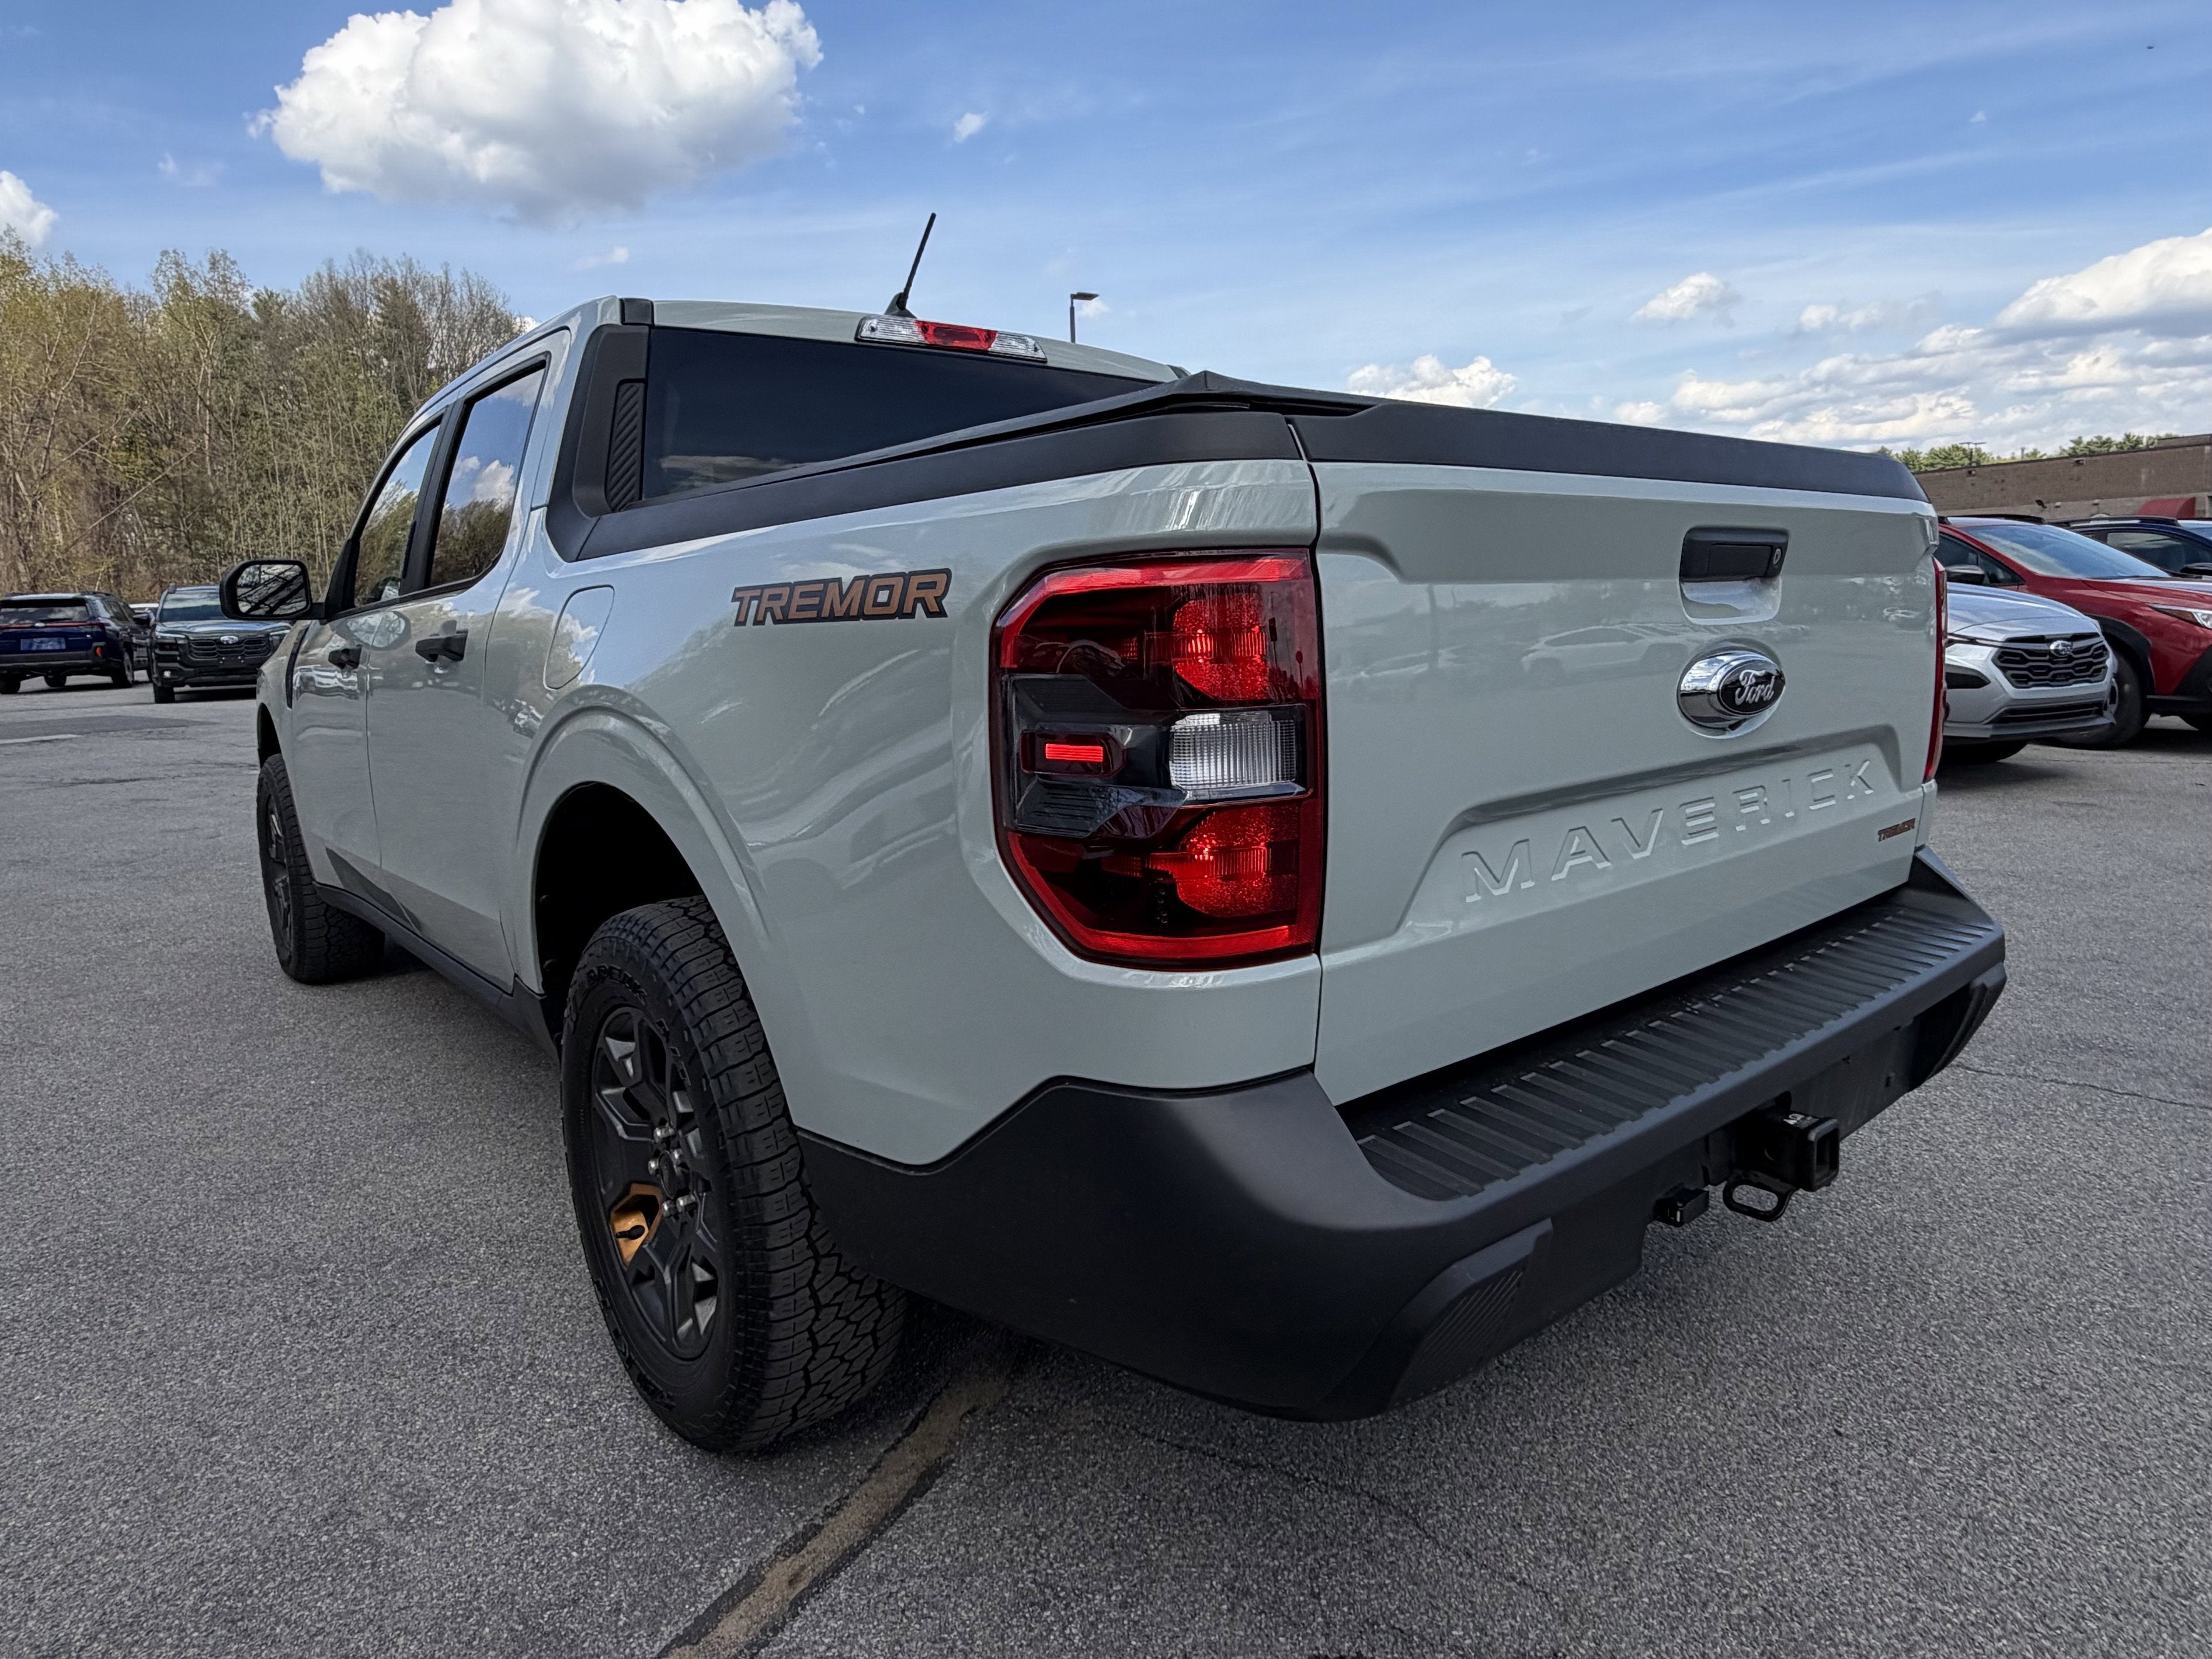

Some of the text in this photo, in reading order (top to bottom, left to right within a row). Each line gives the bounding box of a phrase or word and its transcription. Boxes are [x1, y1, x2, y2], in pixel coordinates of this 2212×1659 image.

[731, 568, 952, 627] TREMOR
[1735, 669, 1775, 705] Ford
[1461, 759, 1874, 903] MAVERICK
